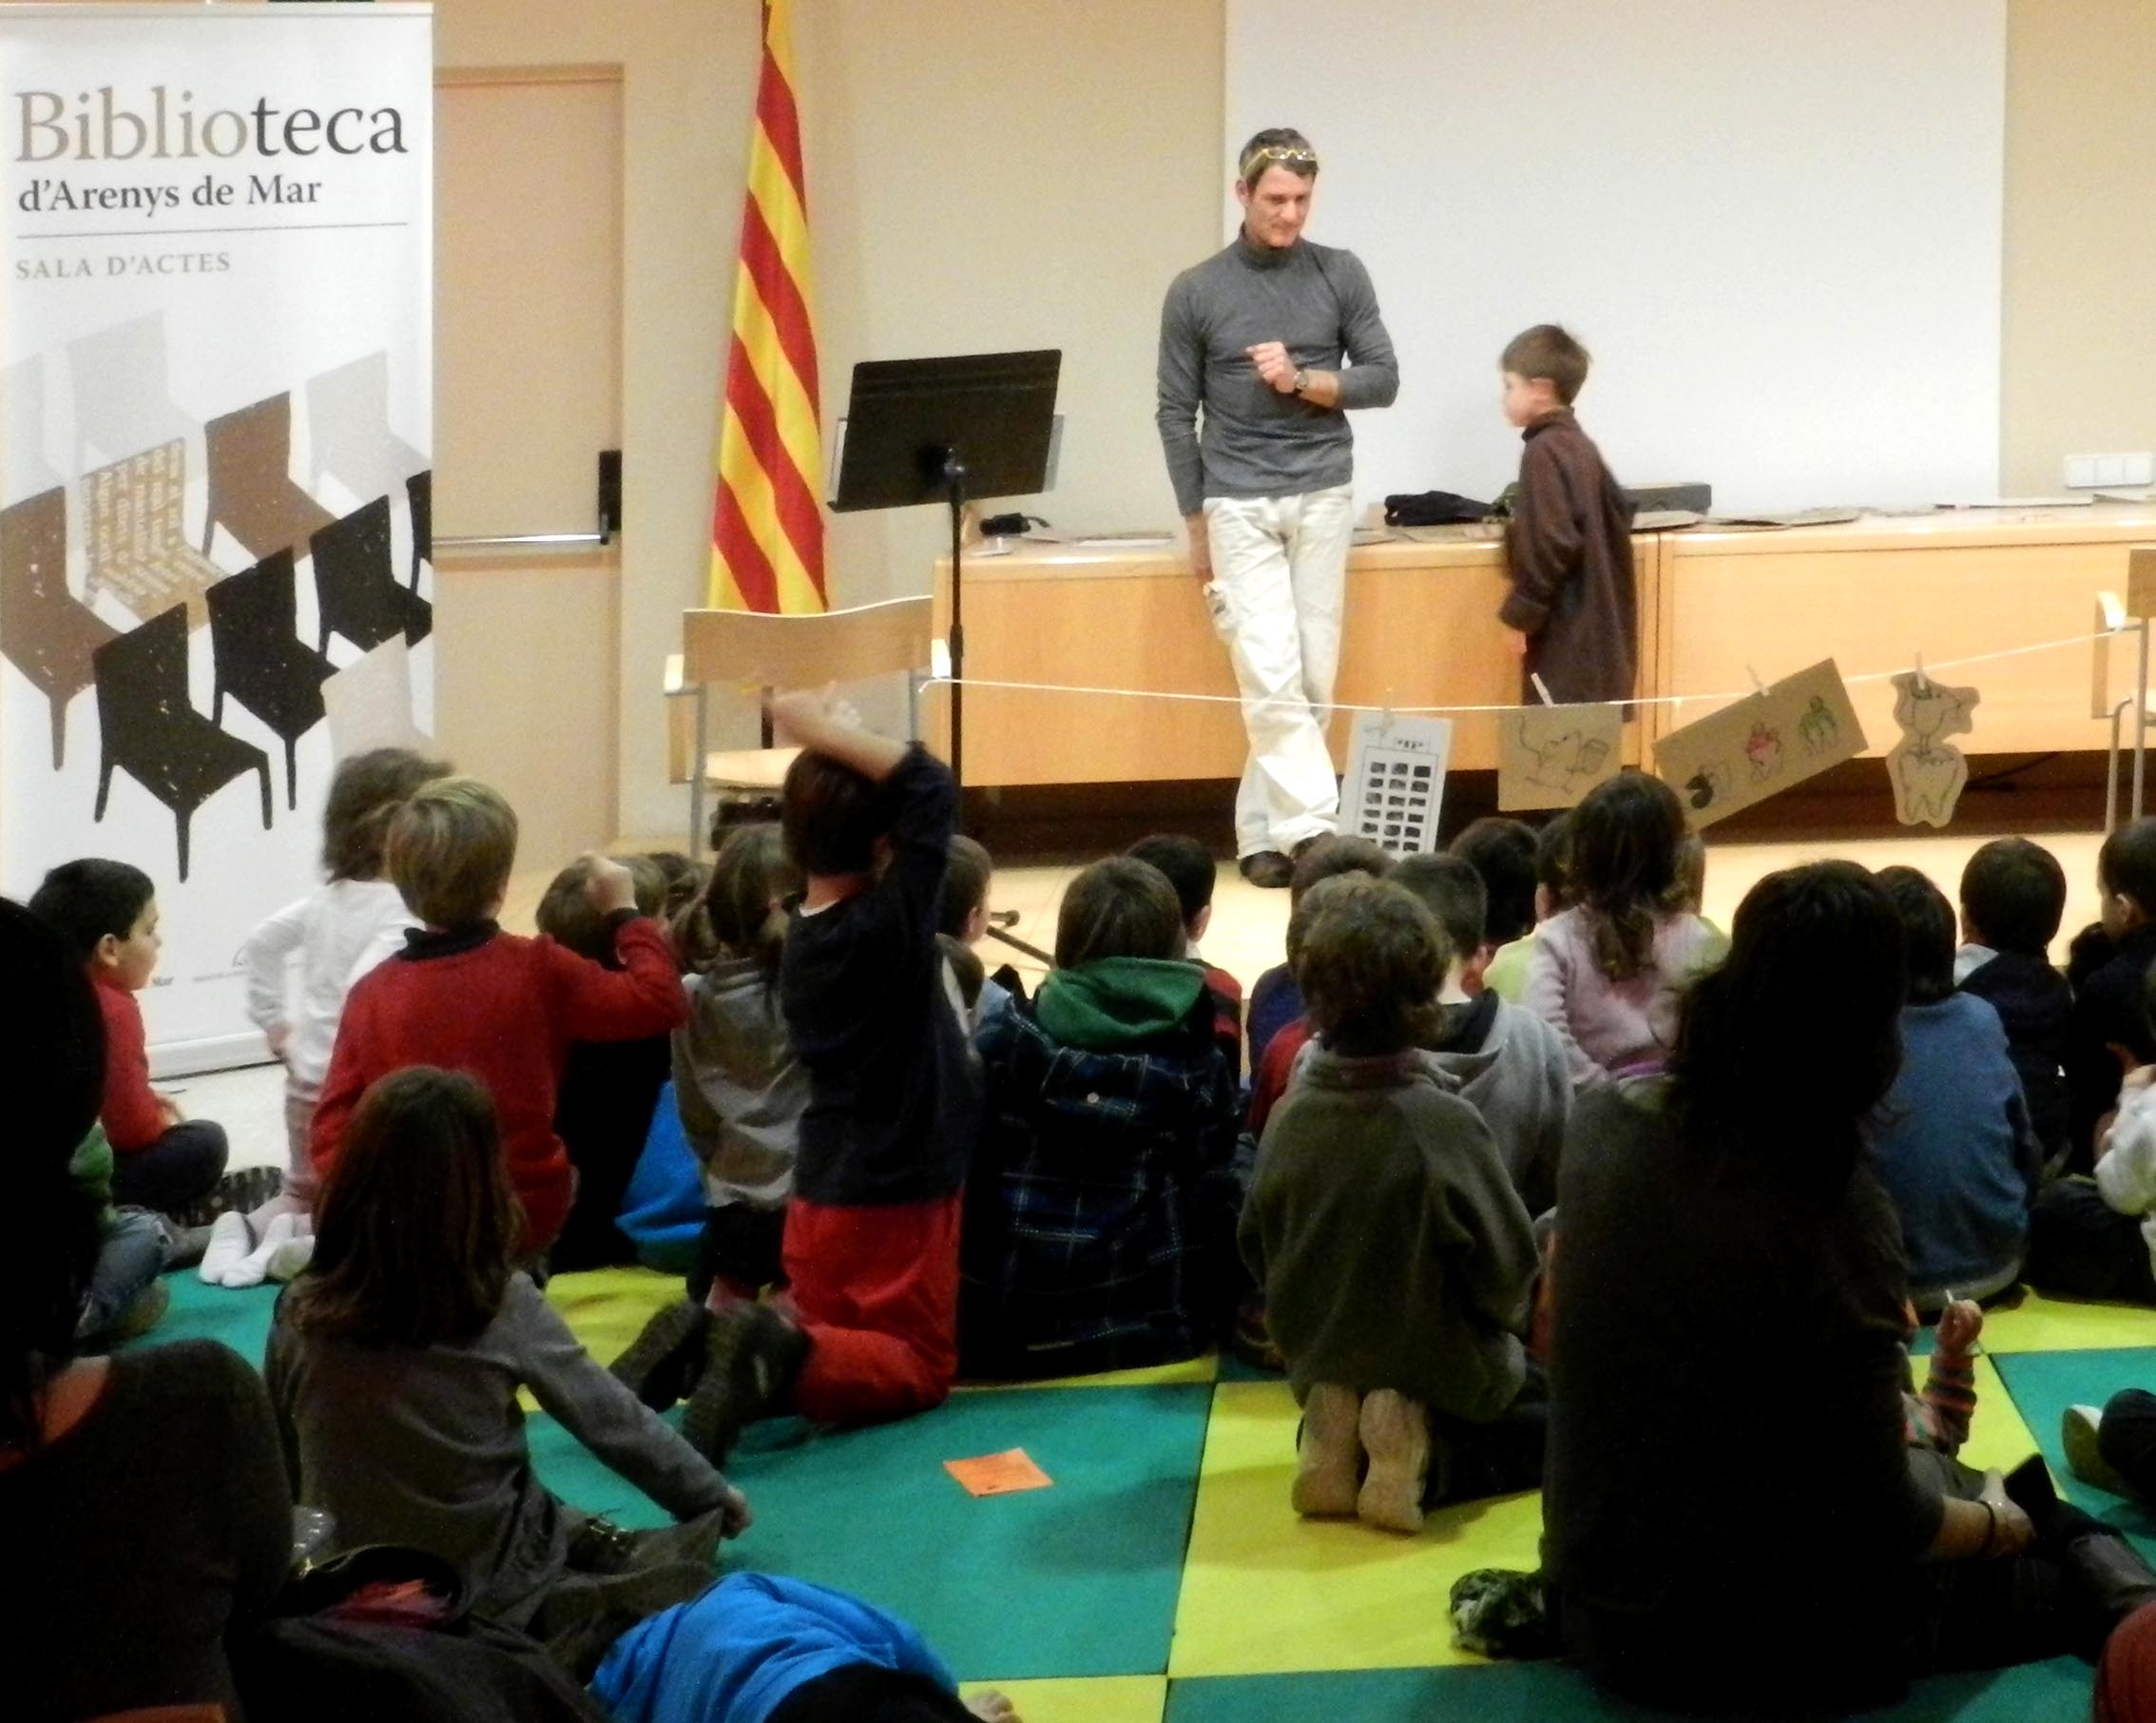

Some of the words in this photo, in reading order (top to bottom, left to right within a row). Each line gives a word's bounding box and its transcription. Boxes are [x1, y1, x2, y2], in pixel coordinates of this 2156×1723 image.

[15, 86, 408, 162] Biblioteca
[18, 179, 181, 217] d'Arenys
[192, 175, 235, 206] de
[247, 174, 321, 205] Mar
[16, 258, 93, 280] SALA
[106, 252, 231, 276] D'ACTES
